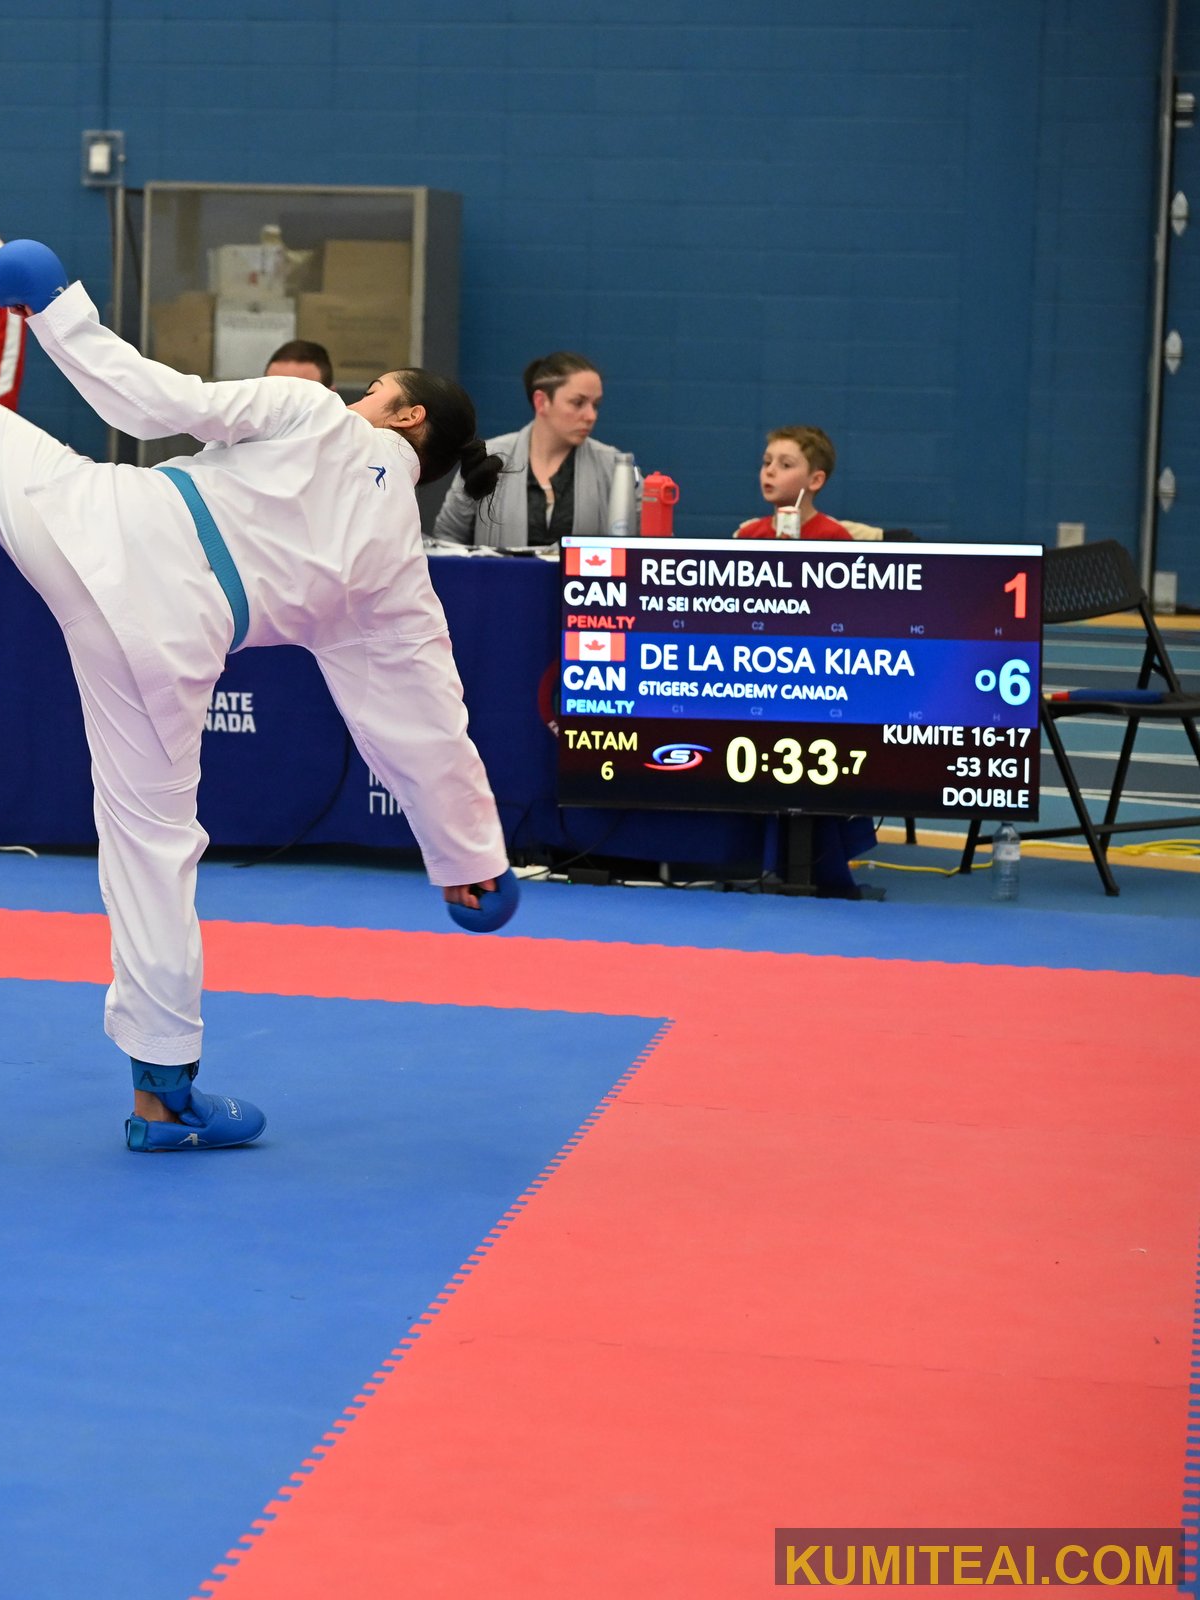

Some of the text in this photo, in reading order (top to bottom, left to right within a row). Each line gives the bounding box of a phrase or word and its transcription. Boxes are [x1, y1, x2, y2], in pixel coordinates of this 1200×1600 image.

[641, 555, 923, 591] REGIMBAL NOÉMIE
[563, 580, 627, 607] CAN
[1003, 572, 1027, 619] 1
[638, 595, 664, 612] TAI
[666, 596, 689, 612] SEI
[743, 597, 811, 615] CANADA
[567, 614, 636, 630] PENALTY
[672, 619, 685, 629] C1
[751, 621, 765, 631] C2
[830, 622, 844, 633] C3
[910, 625, 925, 635] HC
[640, 643, 915, 677] DE LA ROSA KIARA
[563, 665, 626, 692] CAN
[638, 680, 849, 701] 6TIGERS ACADEMY CANADA
[208, 691, 254, 712] ATE
[566, 698, 635, 715] PENALTY
[564, 729, 638, 751] TATAM
[883, 724, 1031, 748] KUMITE 16-17
[600, 760, 615, 781] 6
[946, 757, 981, 778] -53
[988, 758, 1018, 778] KG
[942, 786, 1030, 809] DOUBLE
